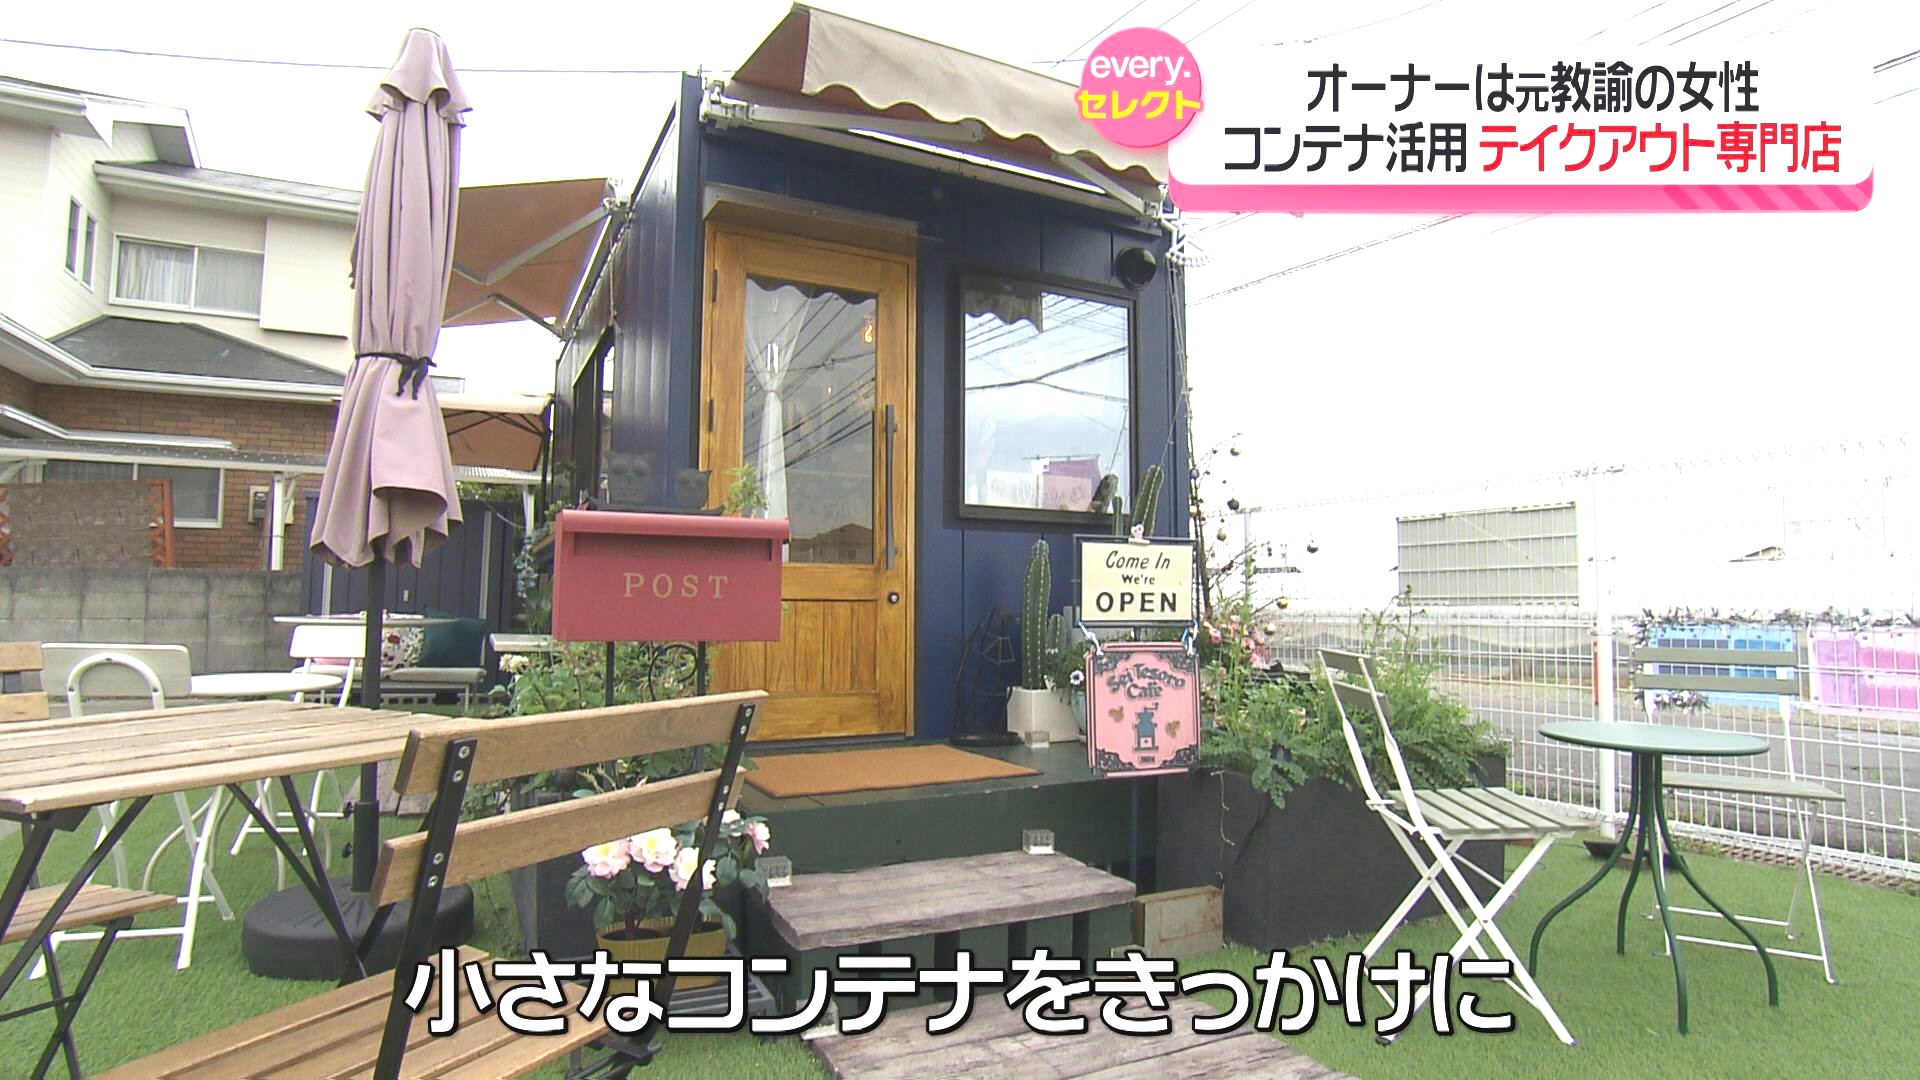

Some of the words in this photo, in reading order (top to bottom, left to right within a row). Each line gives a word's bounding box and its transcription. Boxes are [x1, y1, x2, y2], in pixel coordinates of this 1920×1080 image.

[1105, 550, 1150, 570] Come
[1154, 552, 1171, 570] In
[623, 572, 729, 600] POST
[1121, 573, 1156, 586] We're
[1095, 591, 1177, 613] OPEN
[1133, 663, 1186, 688] Tesoro
